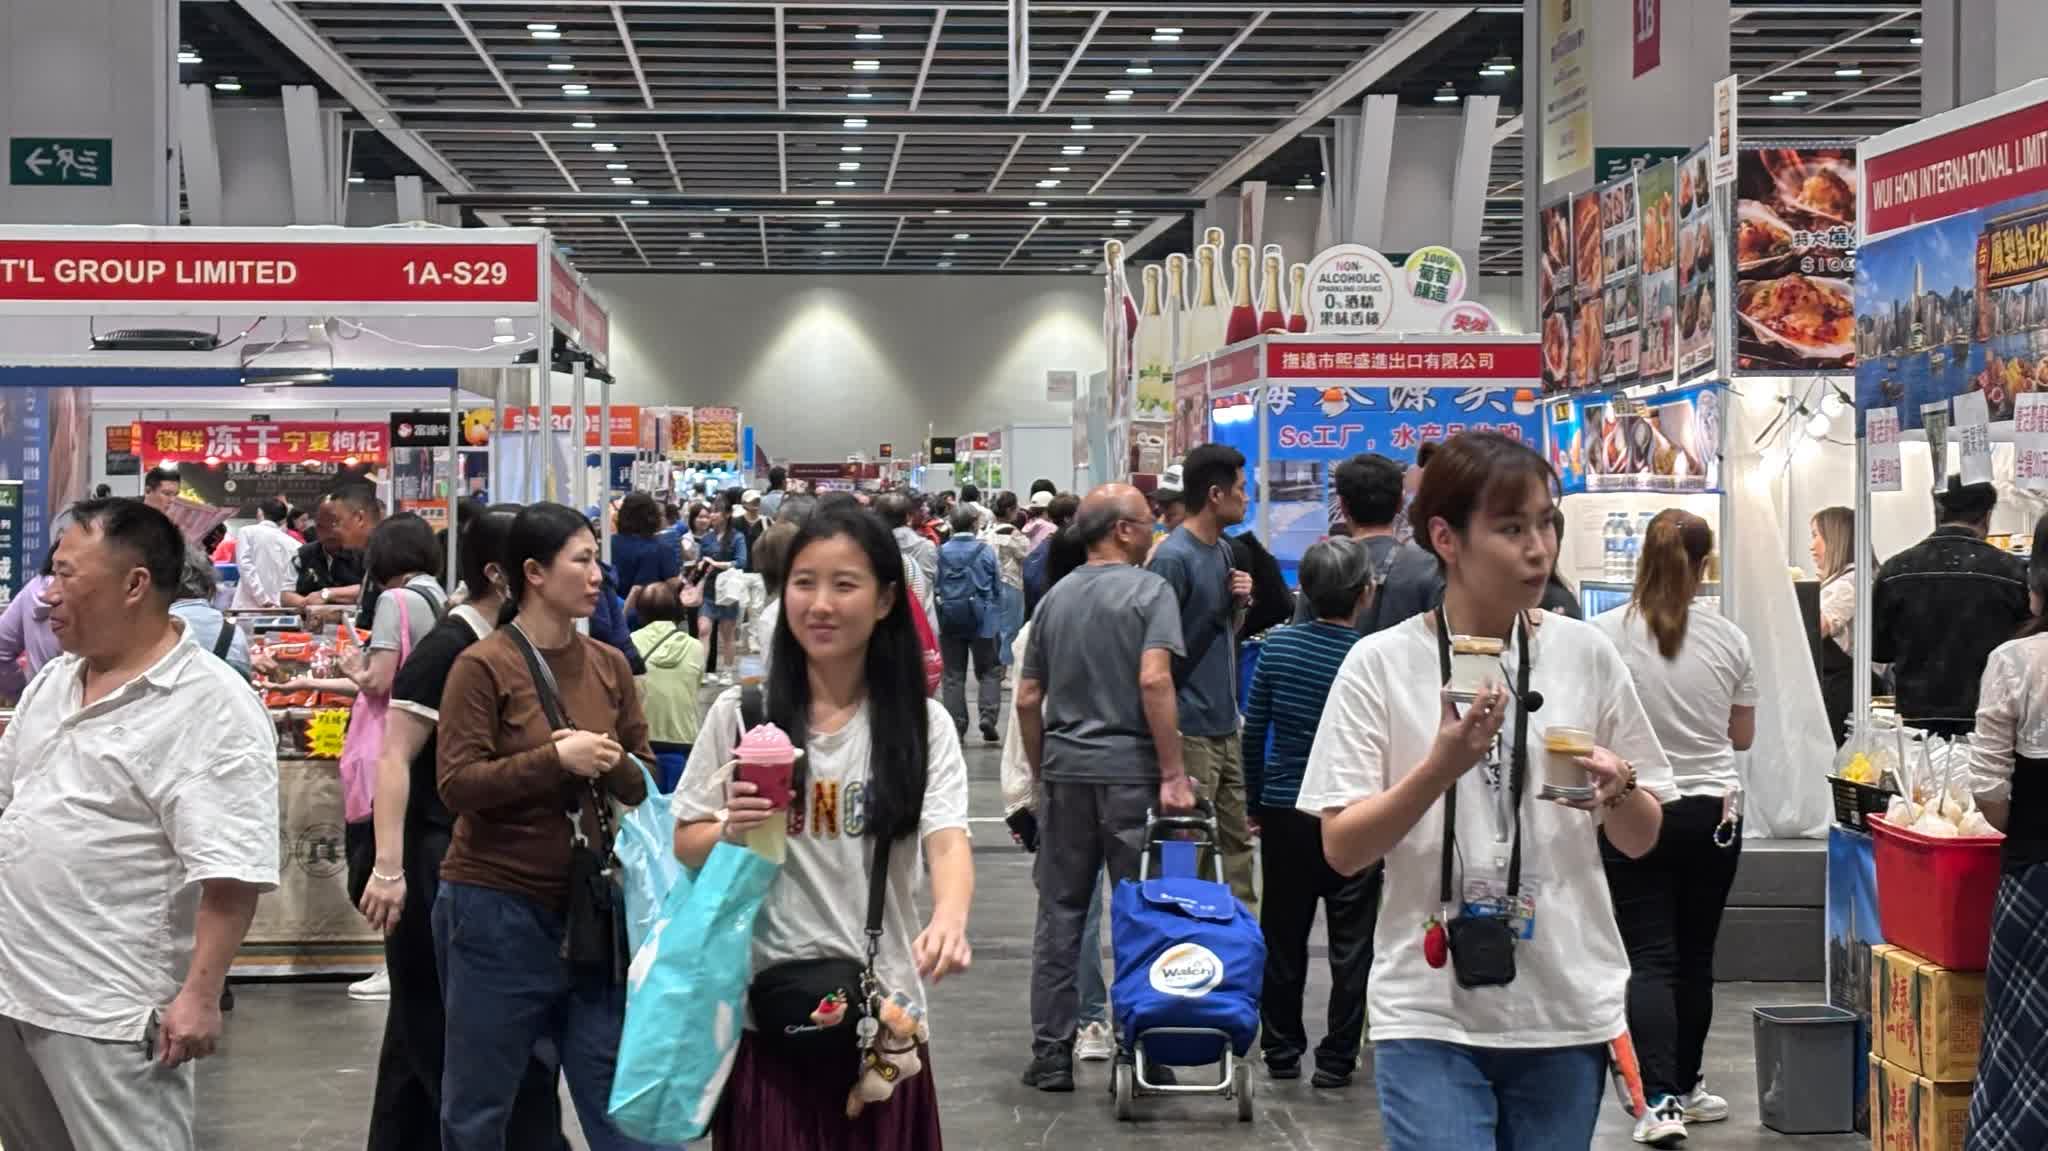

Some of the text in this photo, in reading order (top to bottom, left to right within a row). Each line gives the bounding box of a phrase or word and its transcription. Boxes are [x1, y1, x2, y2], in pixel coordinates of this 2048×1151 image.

[1872, 180, 1893, 211] WUI
[1895, 171, 1918, 206] HON
[1919, 144, 2012, 198] INTERNATIONAL
[54, 260, 166, 284] GROUP
[176, 261, 296, 284] LIMITED
[402, 261, 508, 285] 1A-S29
[1336, 260, 1364, 272] NON-
[1319, 273, 1381, 284] ALCOHOLIC
